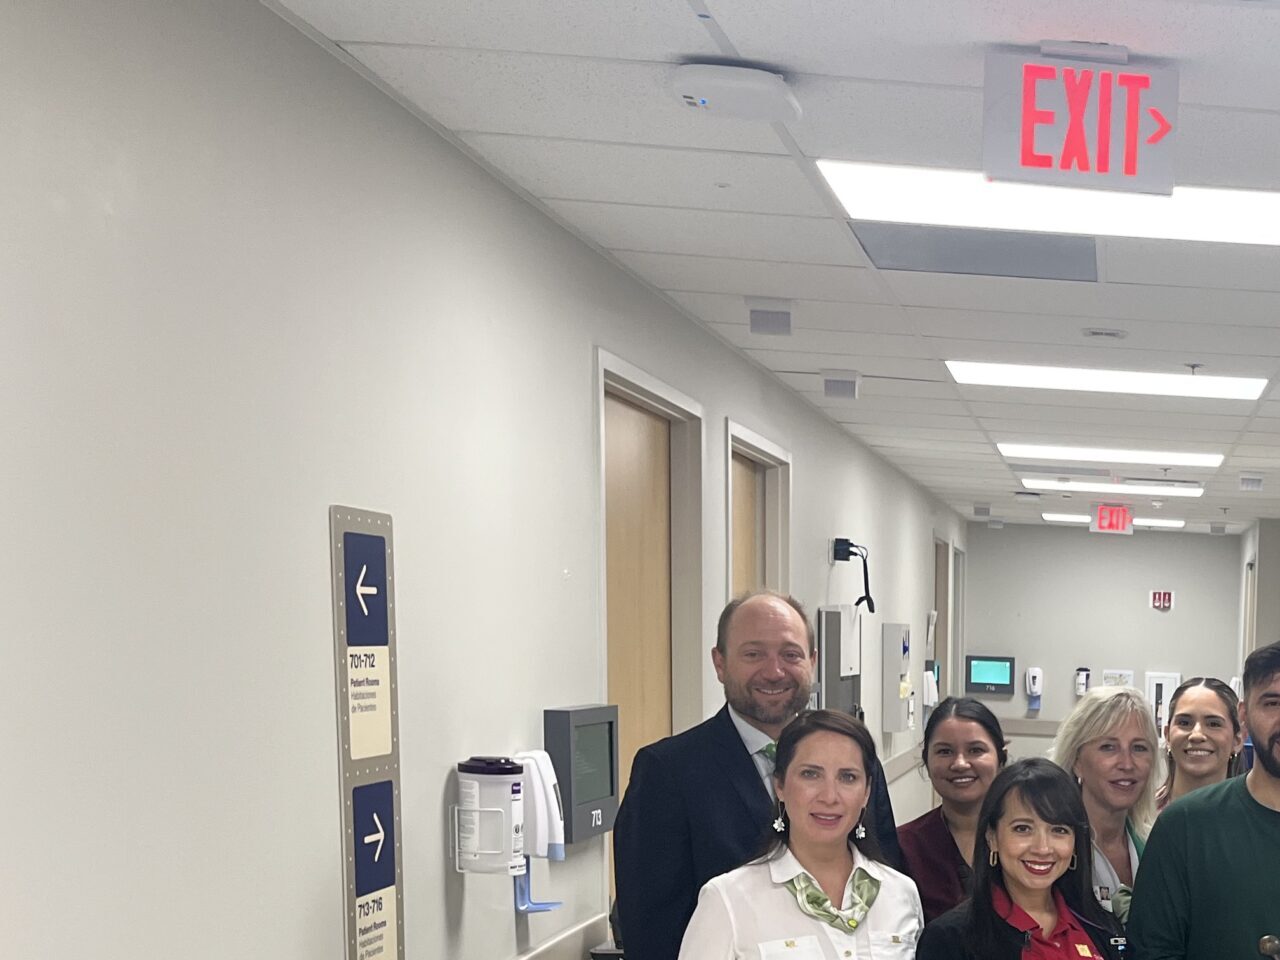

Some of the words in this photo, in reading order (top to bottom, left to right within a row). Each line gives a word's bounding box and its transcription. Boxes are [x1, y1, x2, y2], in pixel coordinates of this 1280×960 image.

[1020, 63, 1151, 176] EXIT
[1097, 504, 1128, 531] EXIT
[350, 653, 375, 668] 701-712
[591, 808, 602, 827] 713
[358, 897, 383, 919] 713-716
